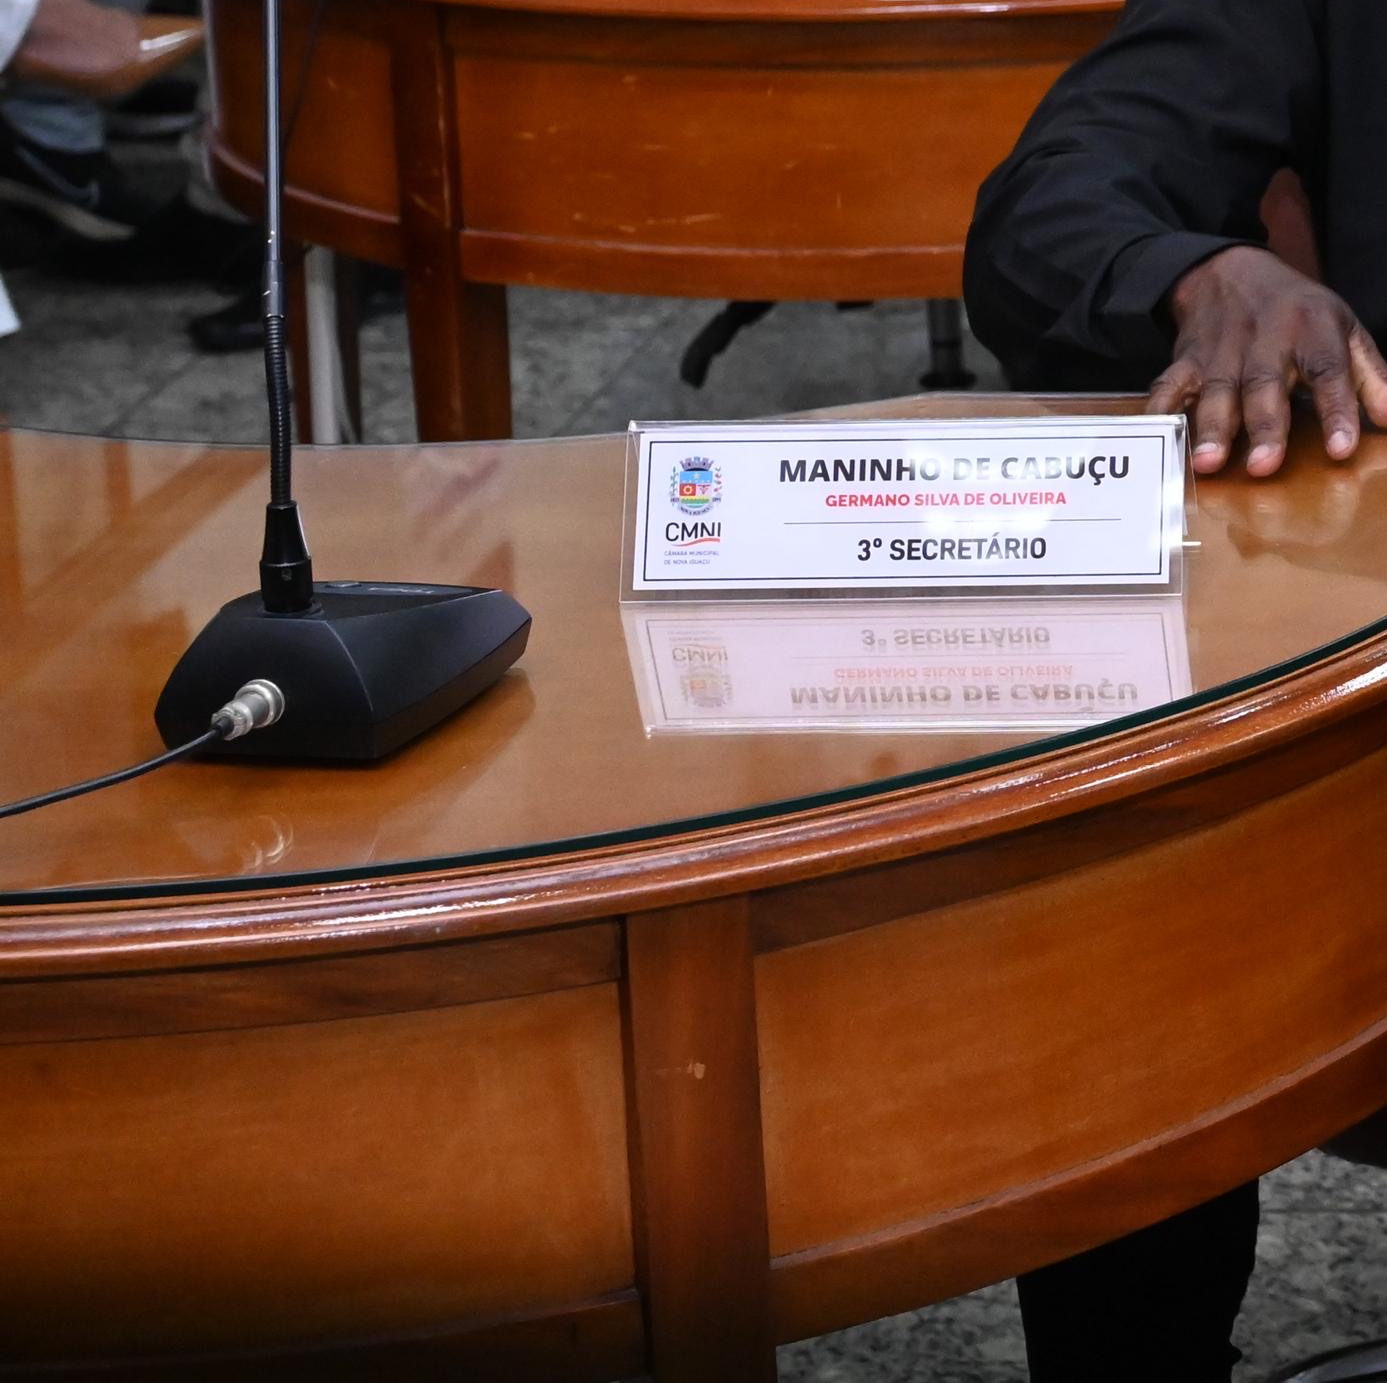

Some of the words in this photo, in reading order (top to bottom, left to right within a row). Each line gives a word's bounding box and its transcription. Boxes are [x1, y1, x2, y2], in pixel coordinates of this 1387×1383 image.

[779, 457, 942, 482] MANINHO
[952, 457, 992, 480] DE
[1000, 455, 1130, 486] CABUÇU
[825, 493, 910, 508] GERMANO
[914, 493, 960, 506] SILVA
[964, 492, 988, 506] DE
[990, 492, 1066, 506] OLIVEIRA
[665, 522, 721, 542] CMNI
[857, 538, 884, 562] 3º
[889, 532, 1047, 562] SECRETÁRIO
